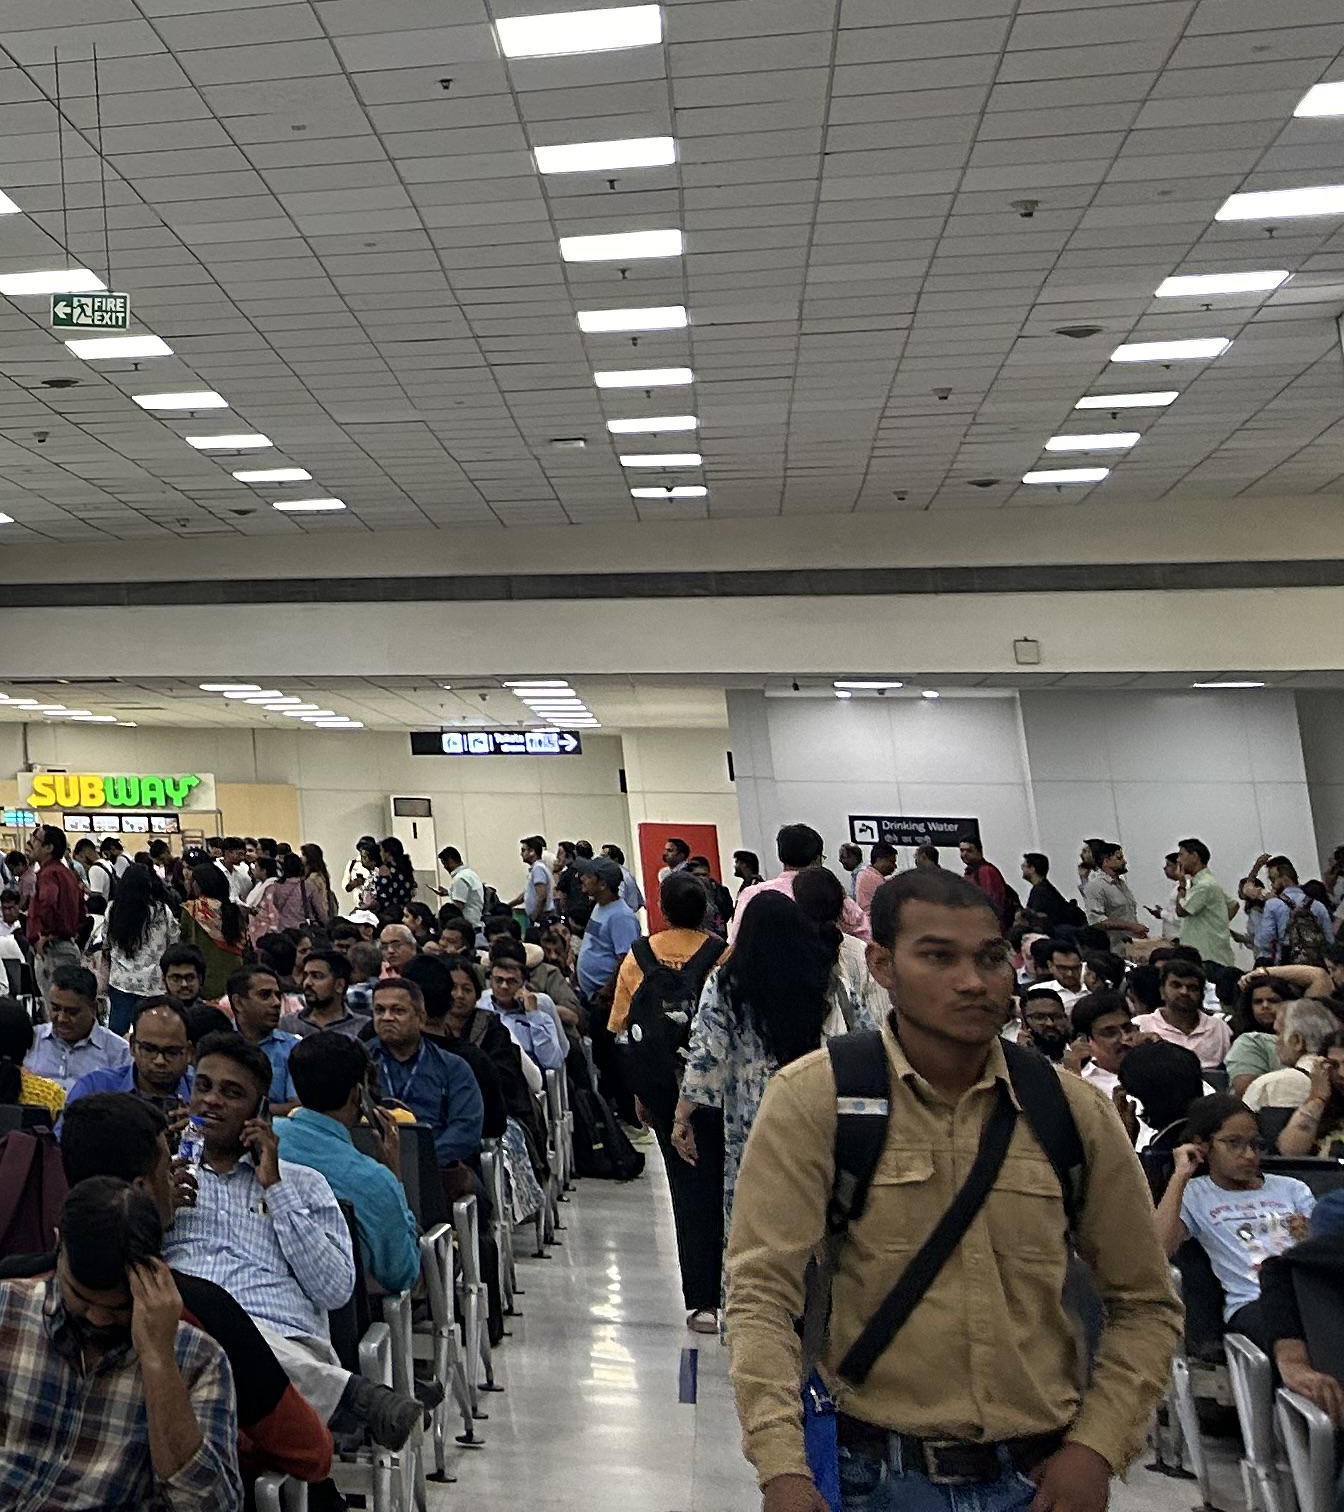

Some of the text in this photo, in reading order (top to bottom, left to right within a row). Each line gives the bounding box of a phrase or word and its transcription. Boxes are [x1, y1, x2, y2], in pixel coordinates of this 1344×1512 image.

[93, 297, 125, 311] FIRE
[94, 312, 125, 326] EXIT
[26, 774, 201, 808] SUBWAY
[881, 820, 959, 833] Drinking Water
